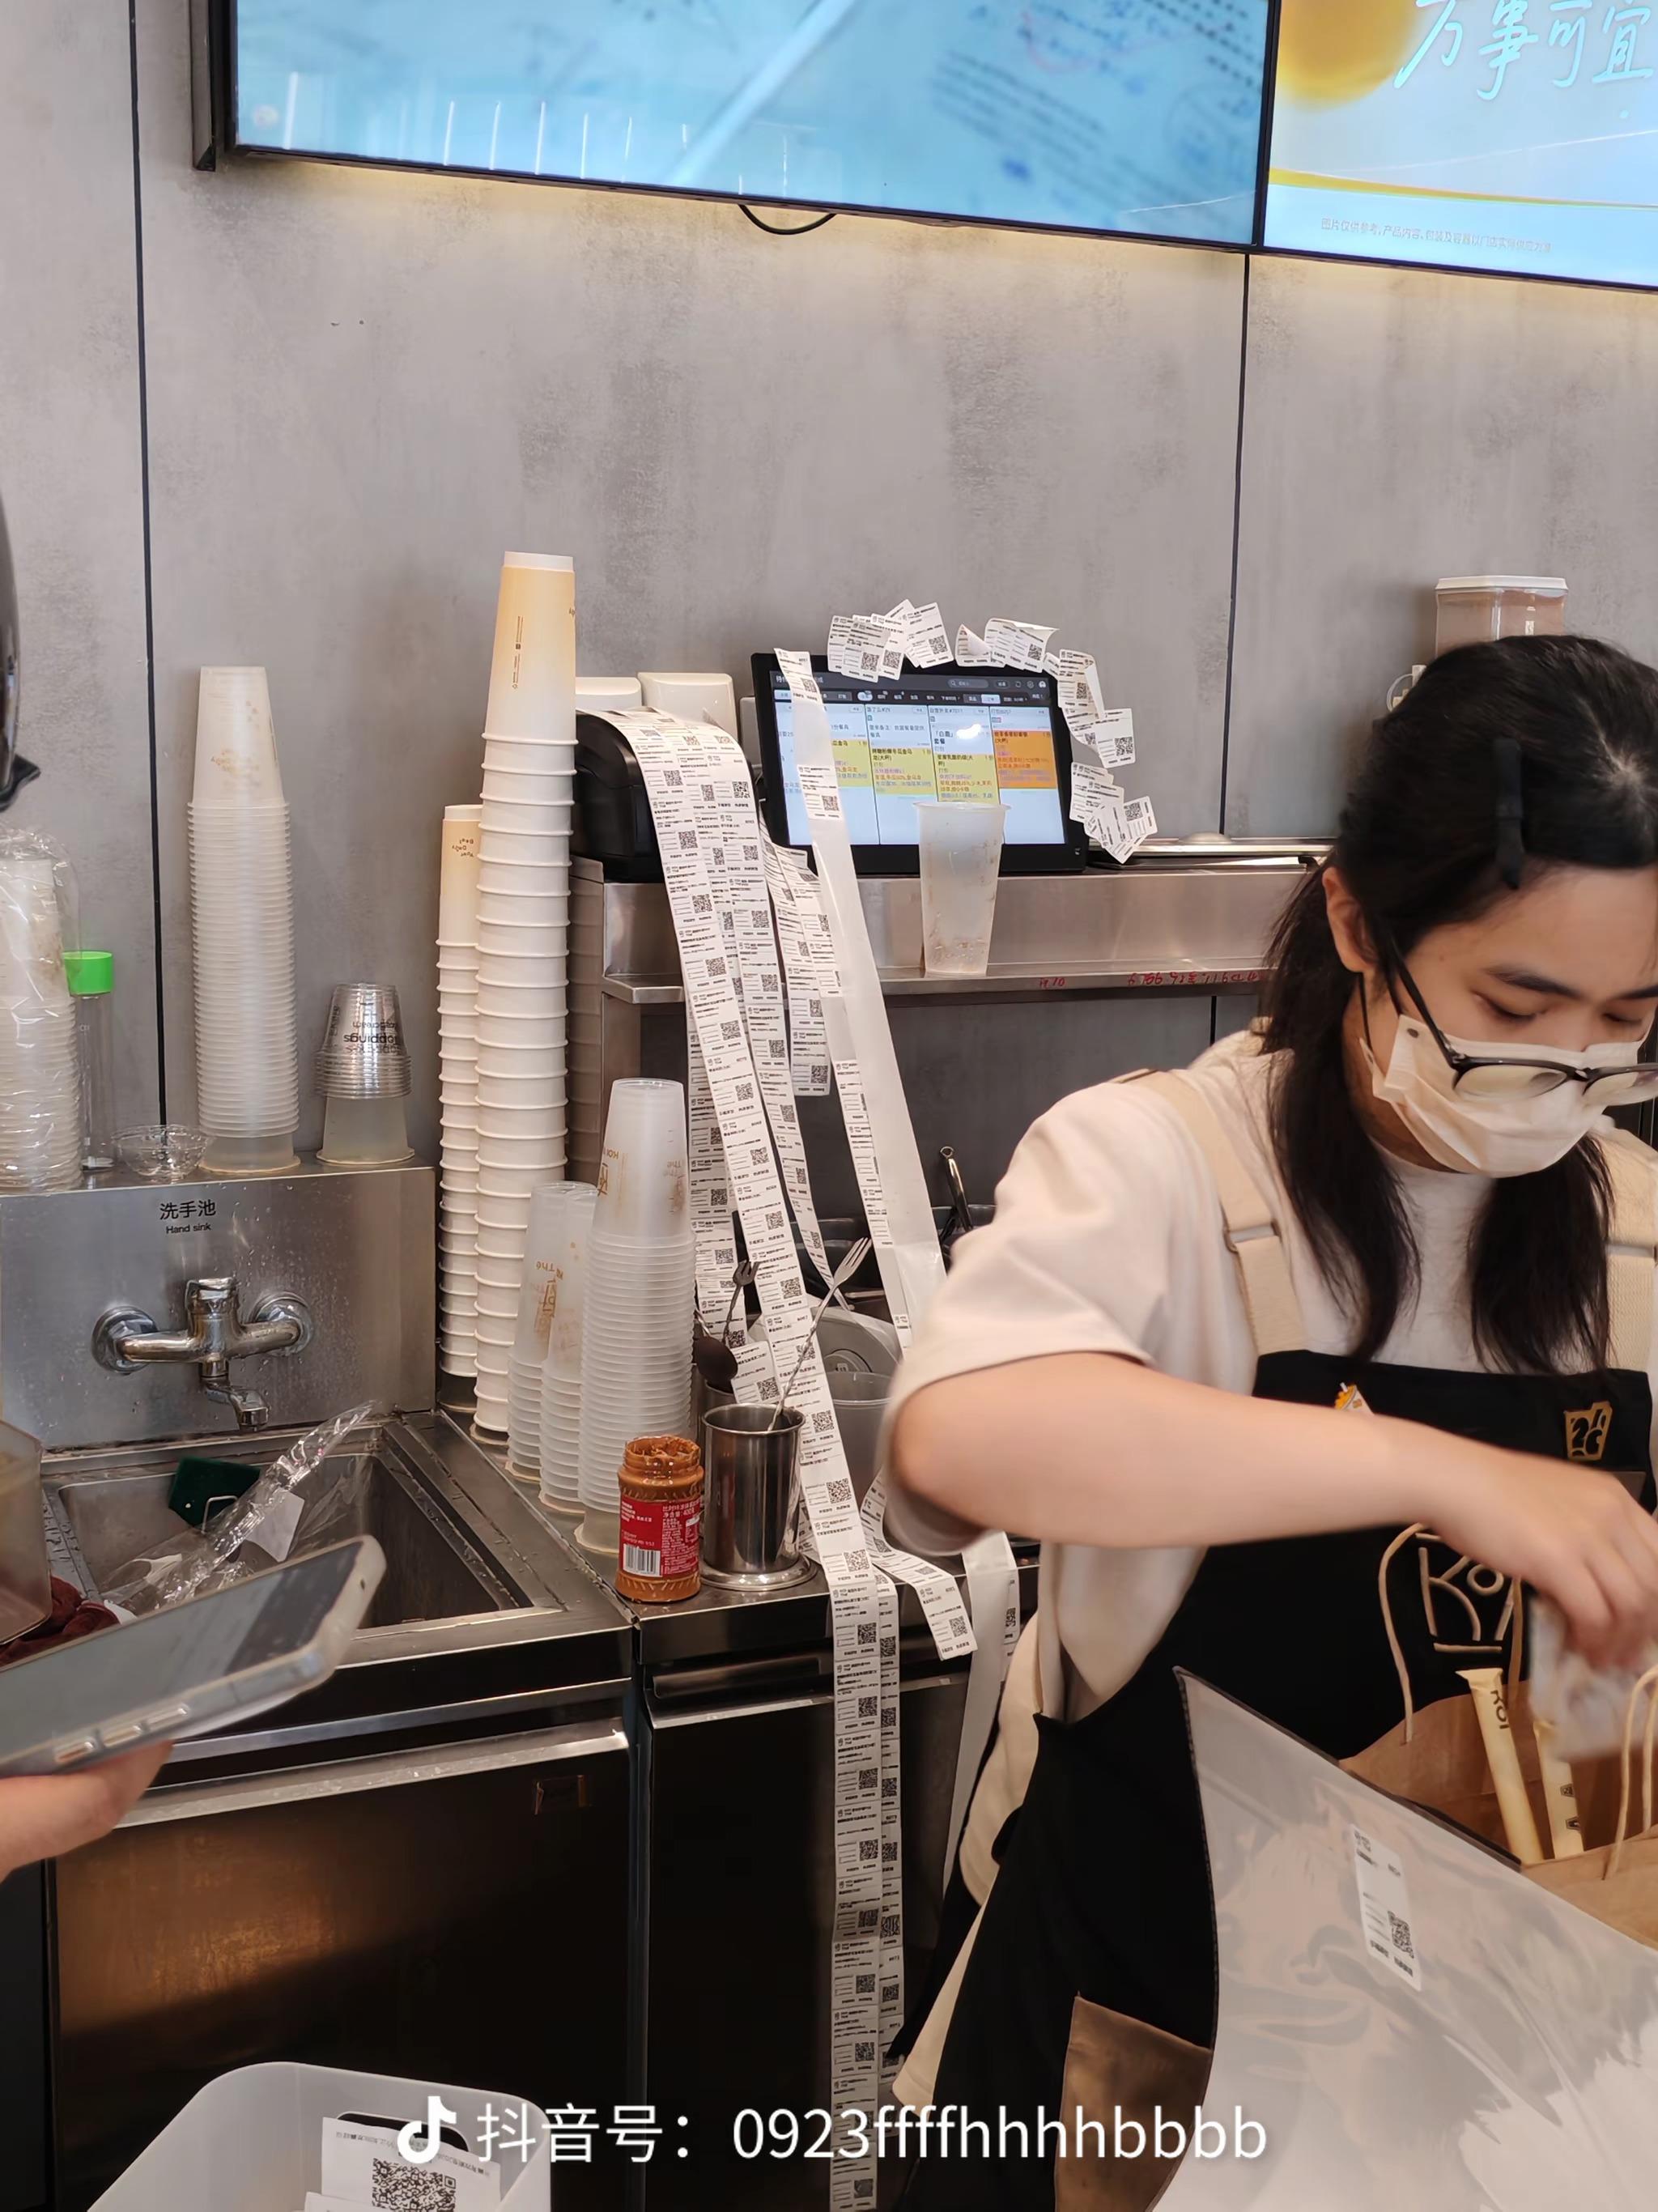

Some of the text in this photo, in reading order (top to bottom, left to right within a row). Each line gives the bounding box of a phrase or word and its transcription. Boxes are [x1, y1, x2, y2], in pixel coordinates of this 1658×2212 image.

[159, 1198, 217, 1220] 洗手池
[165, 1222, 212, 1235] Hand sink
[1490, 1689, 1510, 1730] KOI
